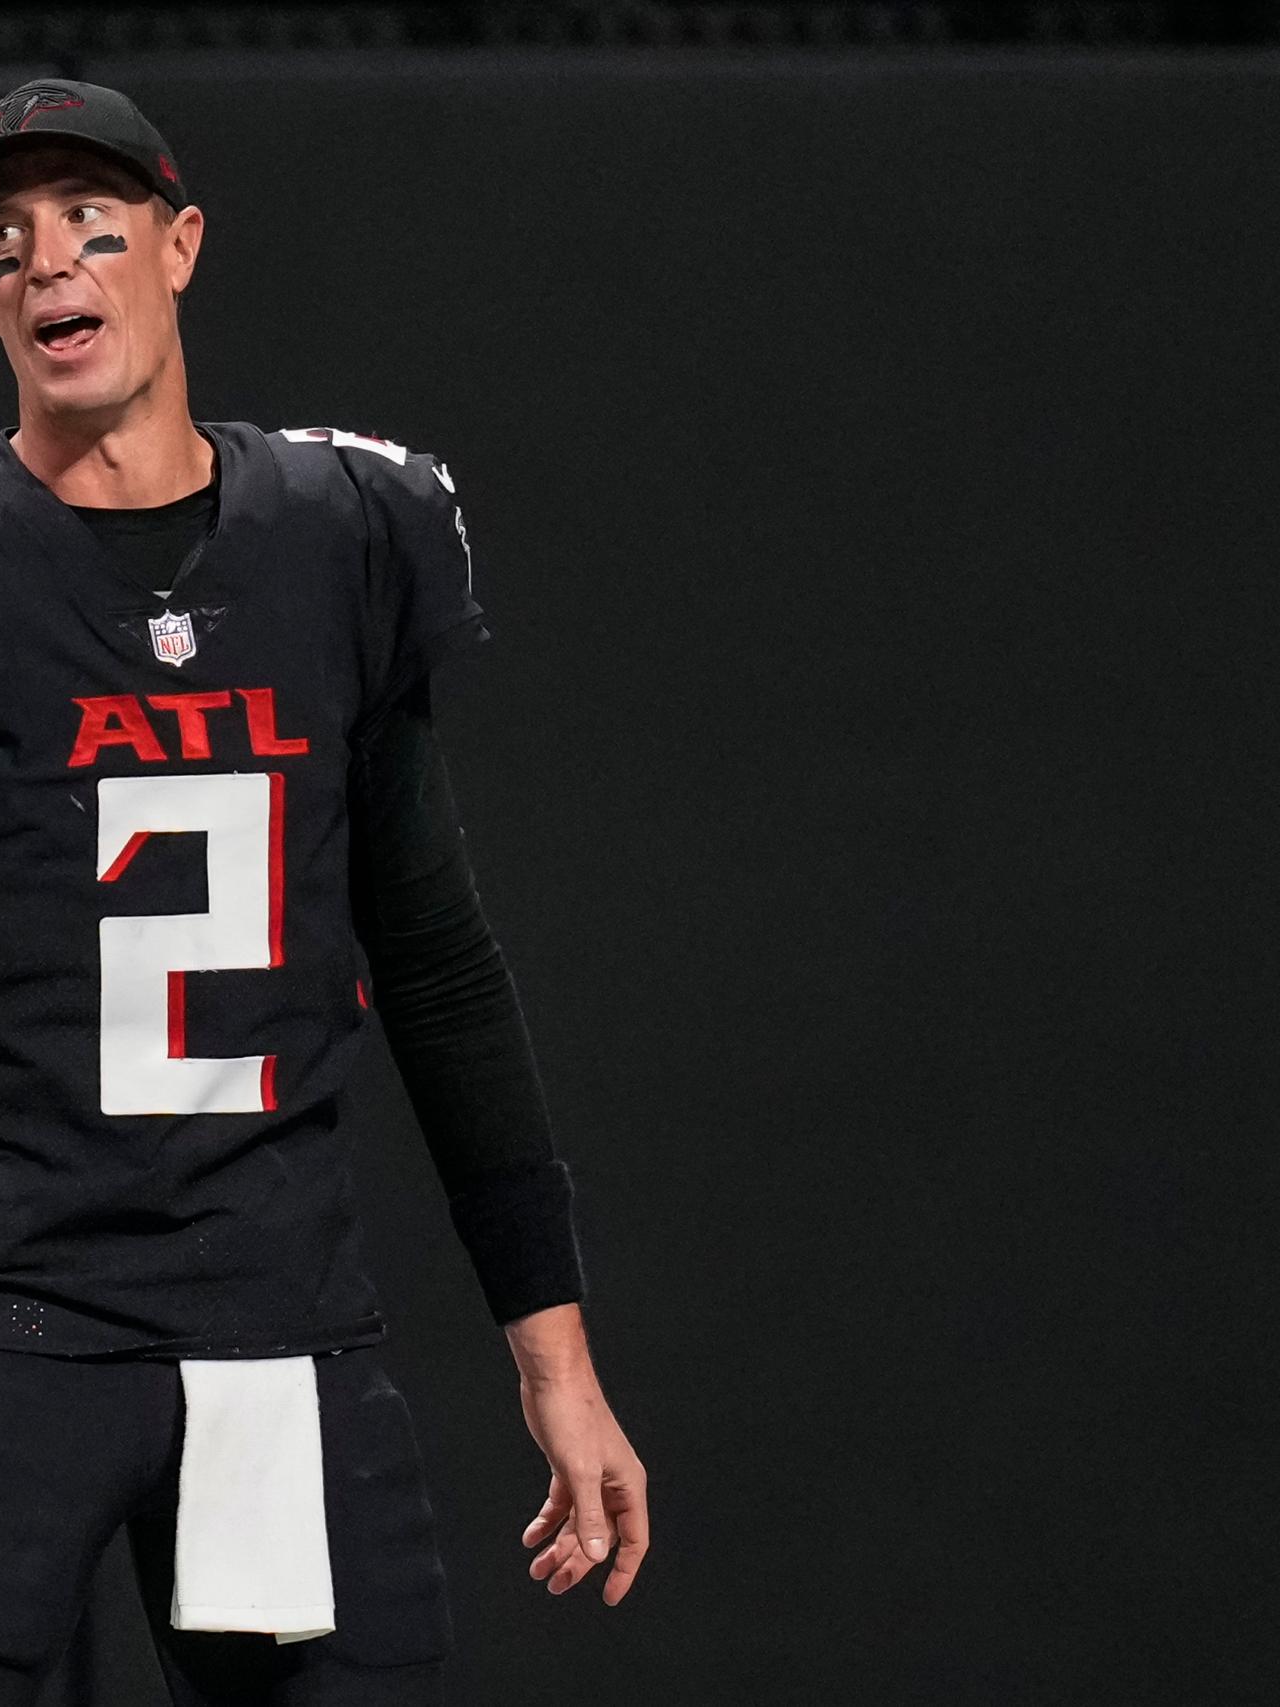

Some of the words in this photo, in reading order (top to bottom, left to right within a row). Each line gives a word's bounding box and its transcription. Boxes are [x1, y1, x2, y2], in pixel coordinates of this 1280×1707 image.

[160, 634, 190, 656] NFL
[67, 688, 309, 768] ATL
[96, 772, 285, 1116] 2
